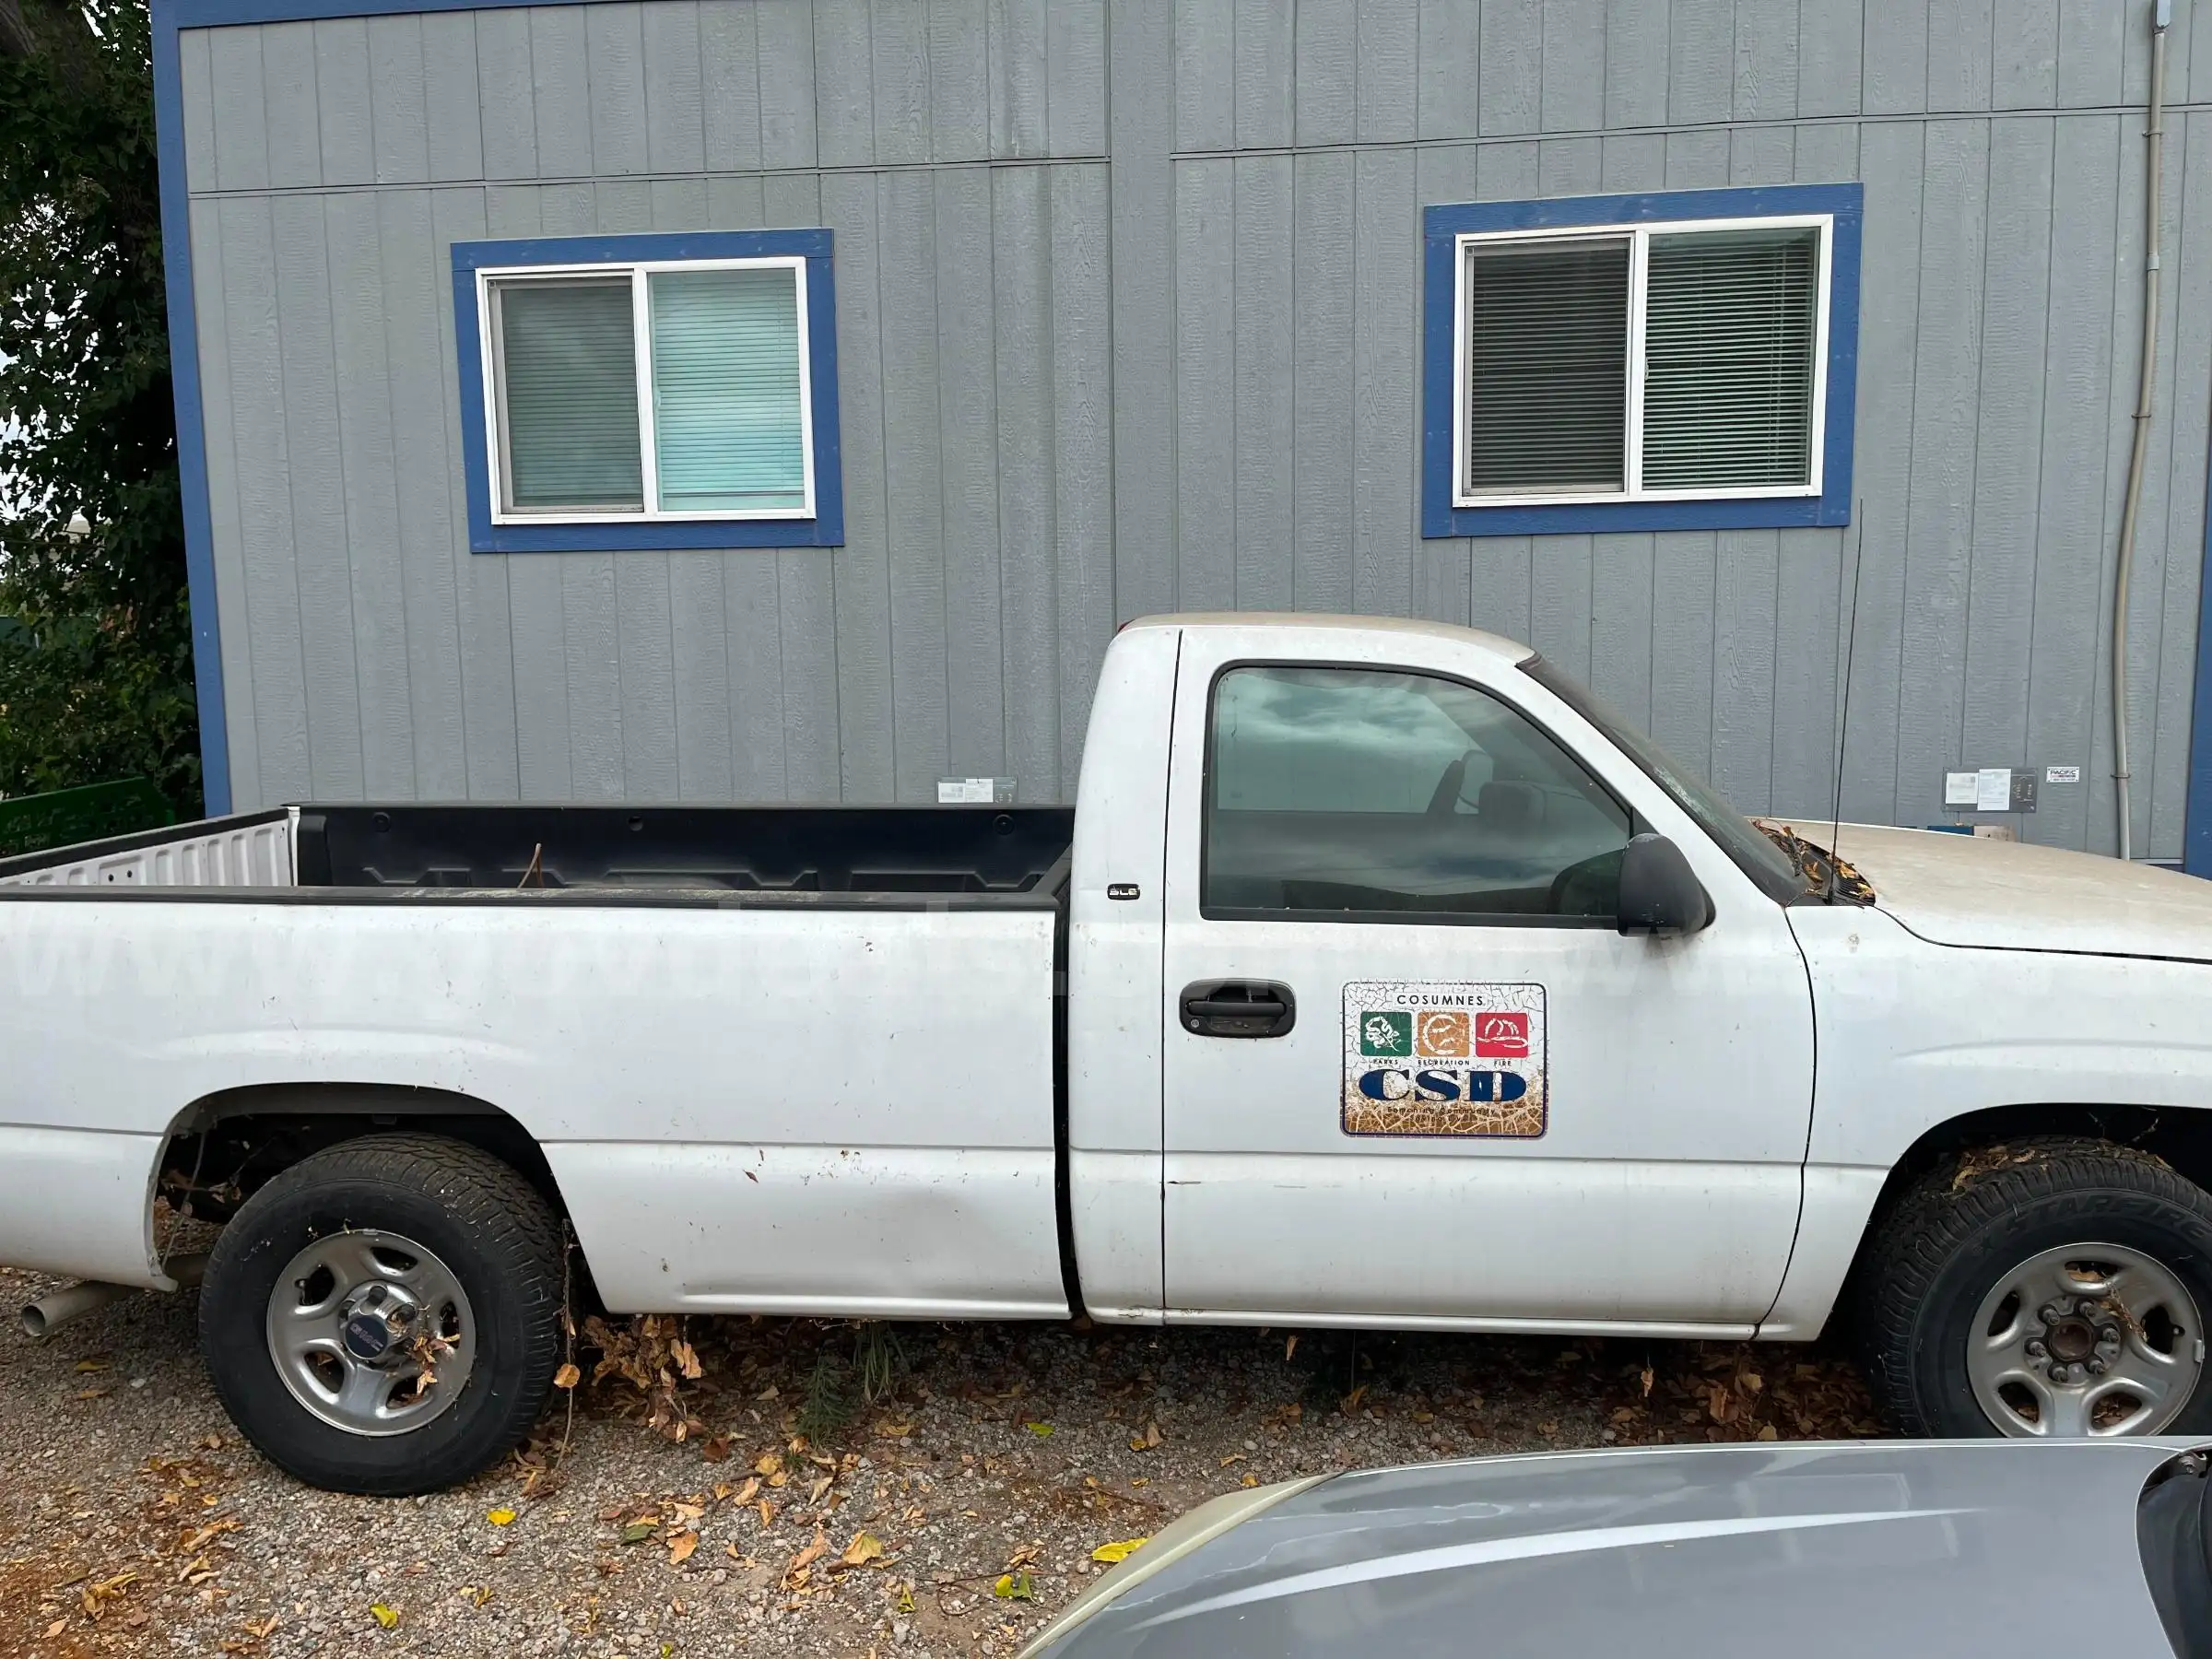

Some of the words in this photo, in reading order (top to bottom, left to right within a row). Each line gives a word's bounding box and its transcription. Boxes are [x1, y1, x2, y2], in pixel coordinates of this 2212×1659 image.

[1396, 994, 1484, 1006] COSUMNES
[1359, 1069, 1527, 1102] CSD
[2005, 1194, 2206, 1240] STARFIRE
